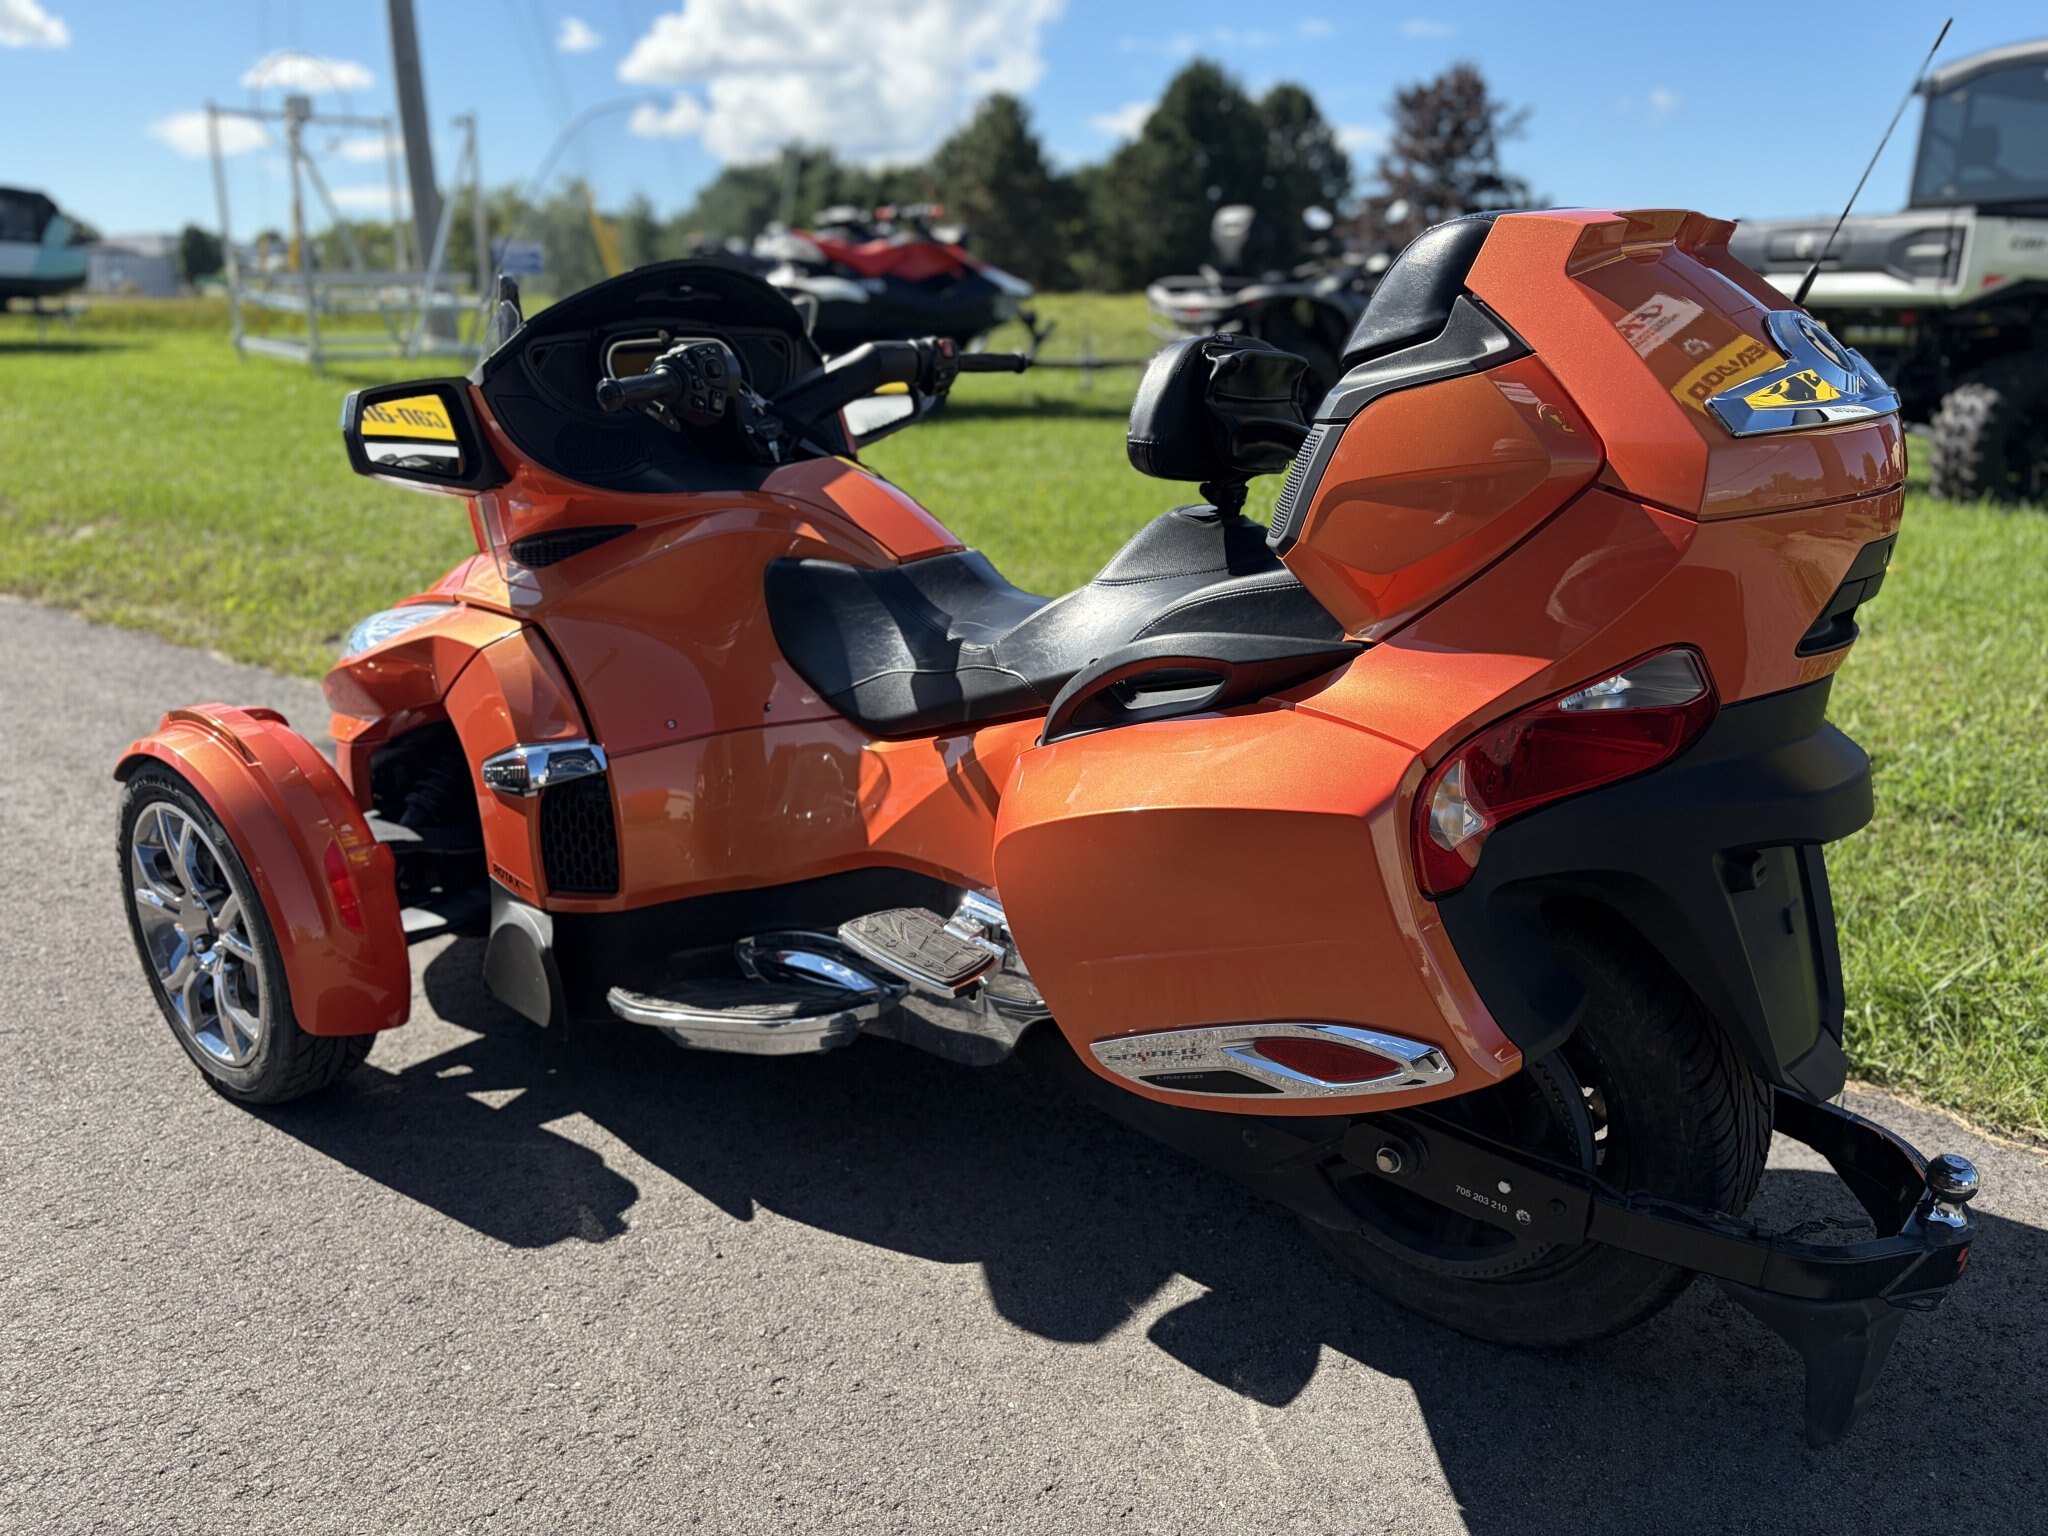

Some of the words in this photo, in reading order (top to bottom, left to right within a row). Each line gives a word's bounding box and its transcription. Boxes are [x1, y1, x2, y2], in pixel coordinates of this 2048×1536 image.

[493, 863, 520, 889] ROTAX
[1455, 1184, 1471, 1198] 705
[1473, 1192, 1489, 1206] 203
[1491, 1200, 1508, 1213] 210
